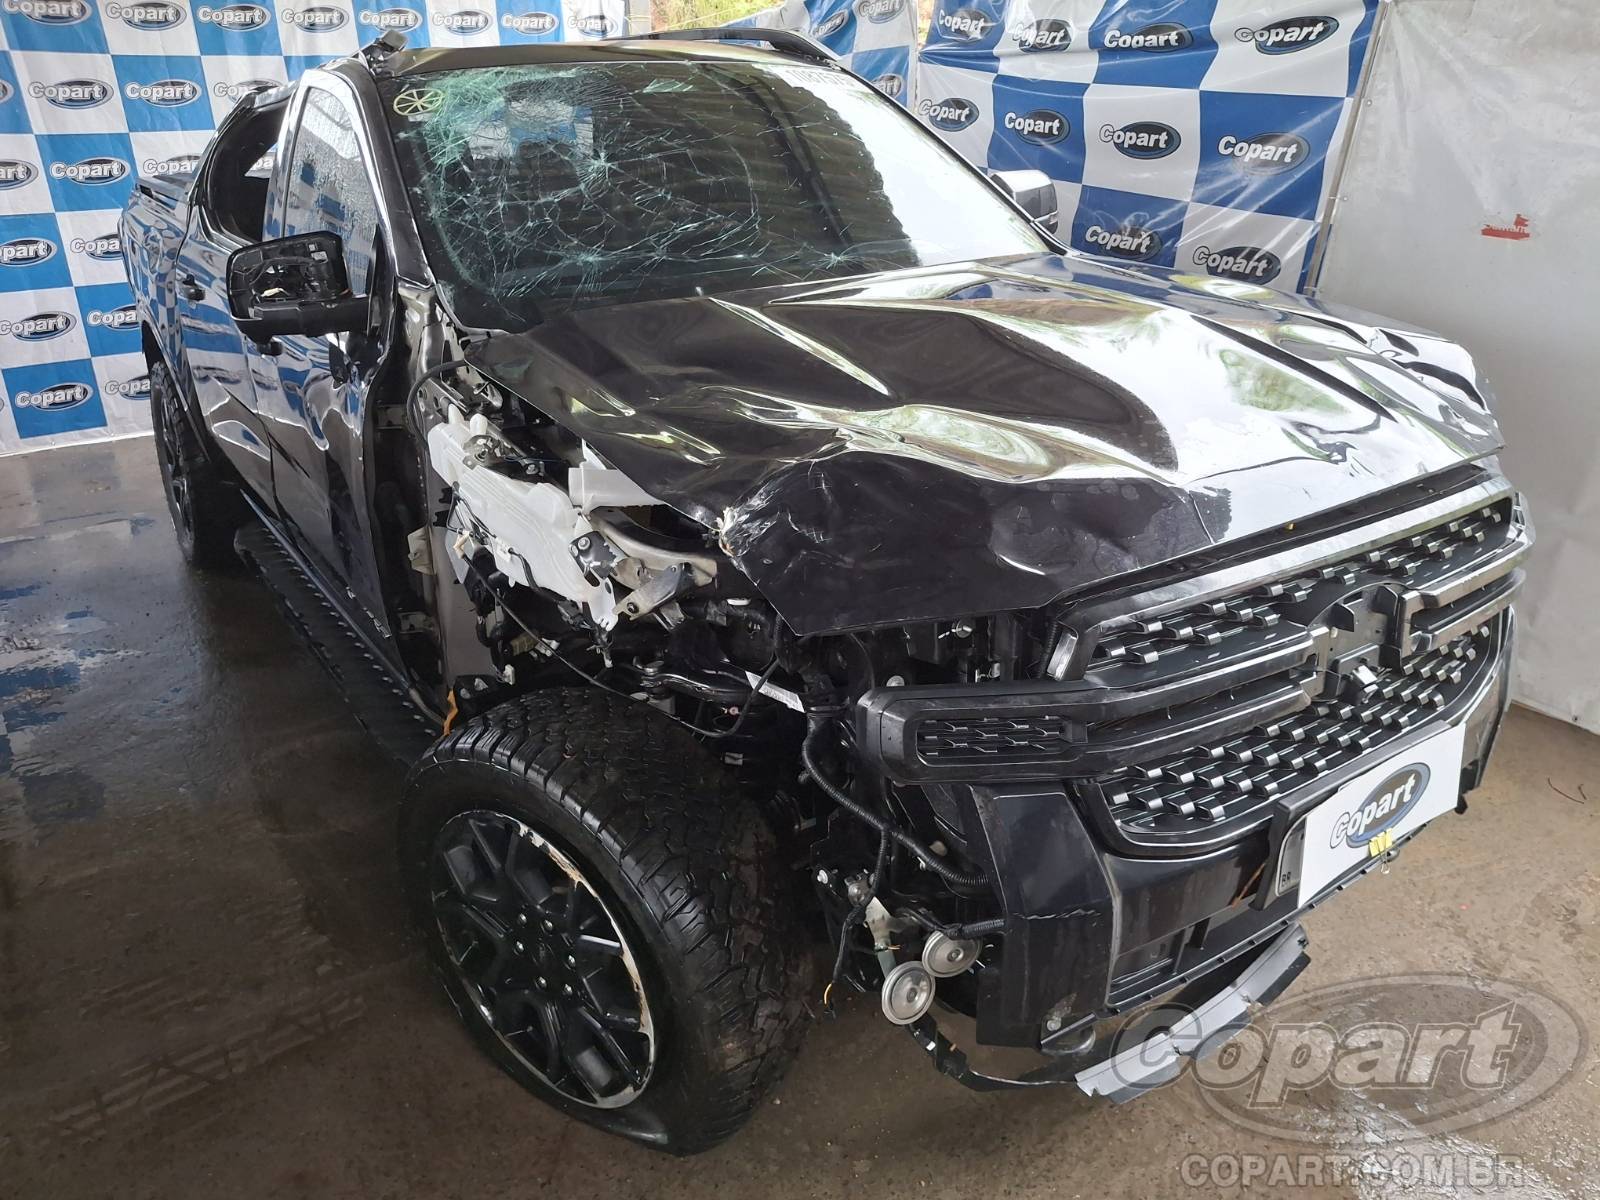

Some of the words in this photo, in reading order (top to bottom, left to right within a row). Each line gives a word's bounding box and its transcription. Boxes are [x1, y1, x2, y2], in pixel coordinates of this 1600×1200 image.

[3, 0, 81, 18] Copart
[106, 3, 177, 25] Copart
[198, 6, 262, 24] Copart
[282, 9, 341, 26] Copart
[359, 9, 417, 28] Copart
[433, 11, 489, 28] Copart
[501, 13, 553, 31] Copart
[938, 9, 985, 38] Copart
[1234, 21, 1326, 44] Copart
[28, 81, 103, 101] Copart
[125, 83, 193, 100] Copart
[918, 99, 971, 122] Copart
[1004, 112, 1060, 136] Copart
[1100, 124, 1168, 149] Copart
[1218, 136, 1298, 162] Copart
[0, 163, 28, 180] art
[50, 157, 122, 179] Copart
[0, 239, 48, 261] part
[70, 238, 120, 257] Copa
[1085, 226, 1151, 254] Copart
[1193, 246, 1271, 277] Copart
[0, 313, 67, 336] Copart
[87, 309, 137, 327] Copa
[15, 384, 84, 408] Copart
[105, 380, 150, 398] Copa
[1330, 773, 1416, 849] Copart
